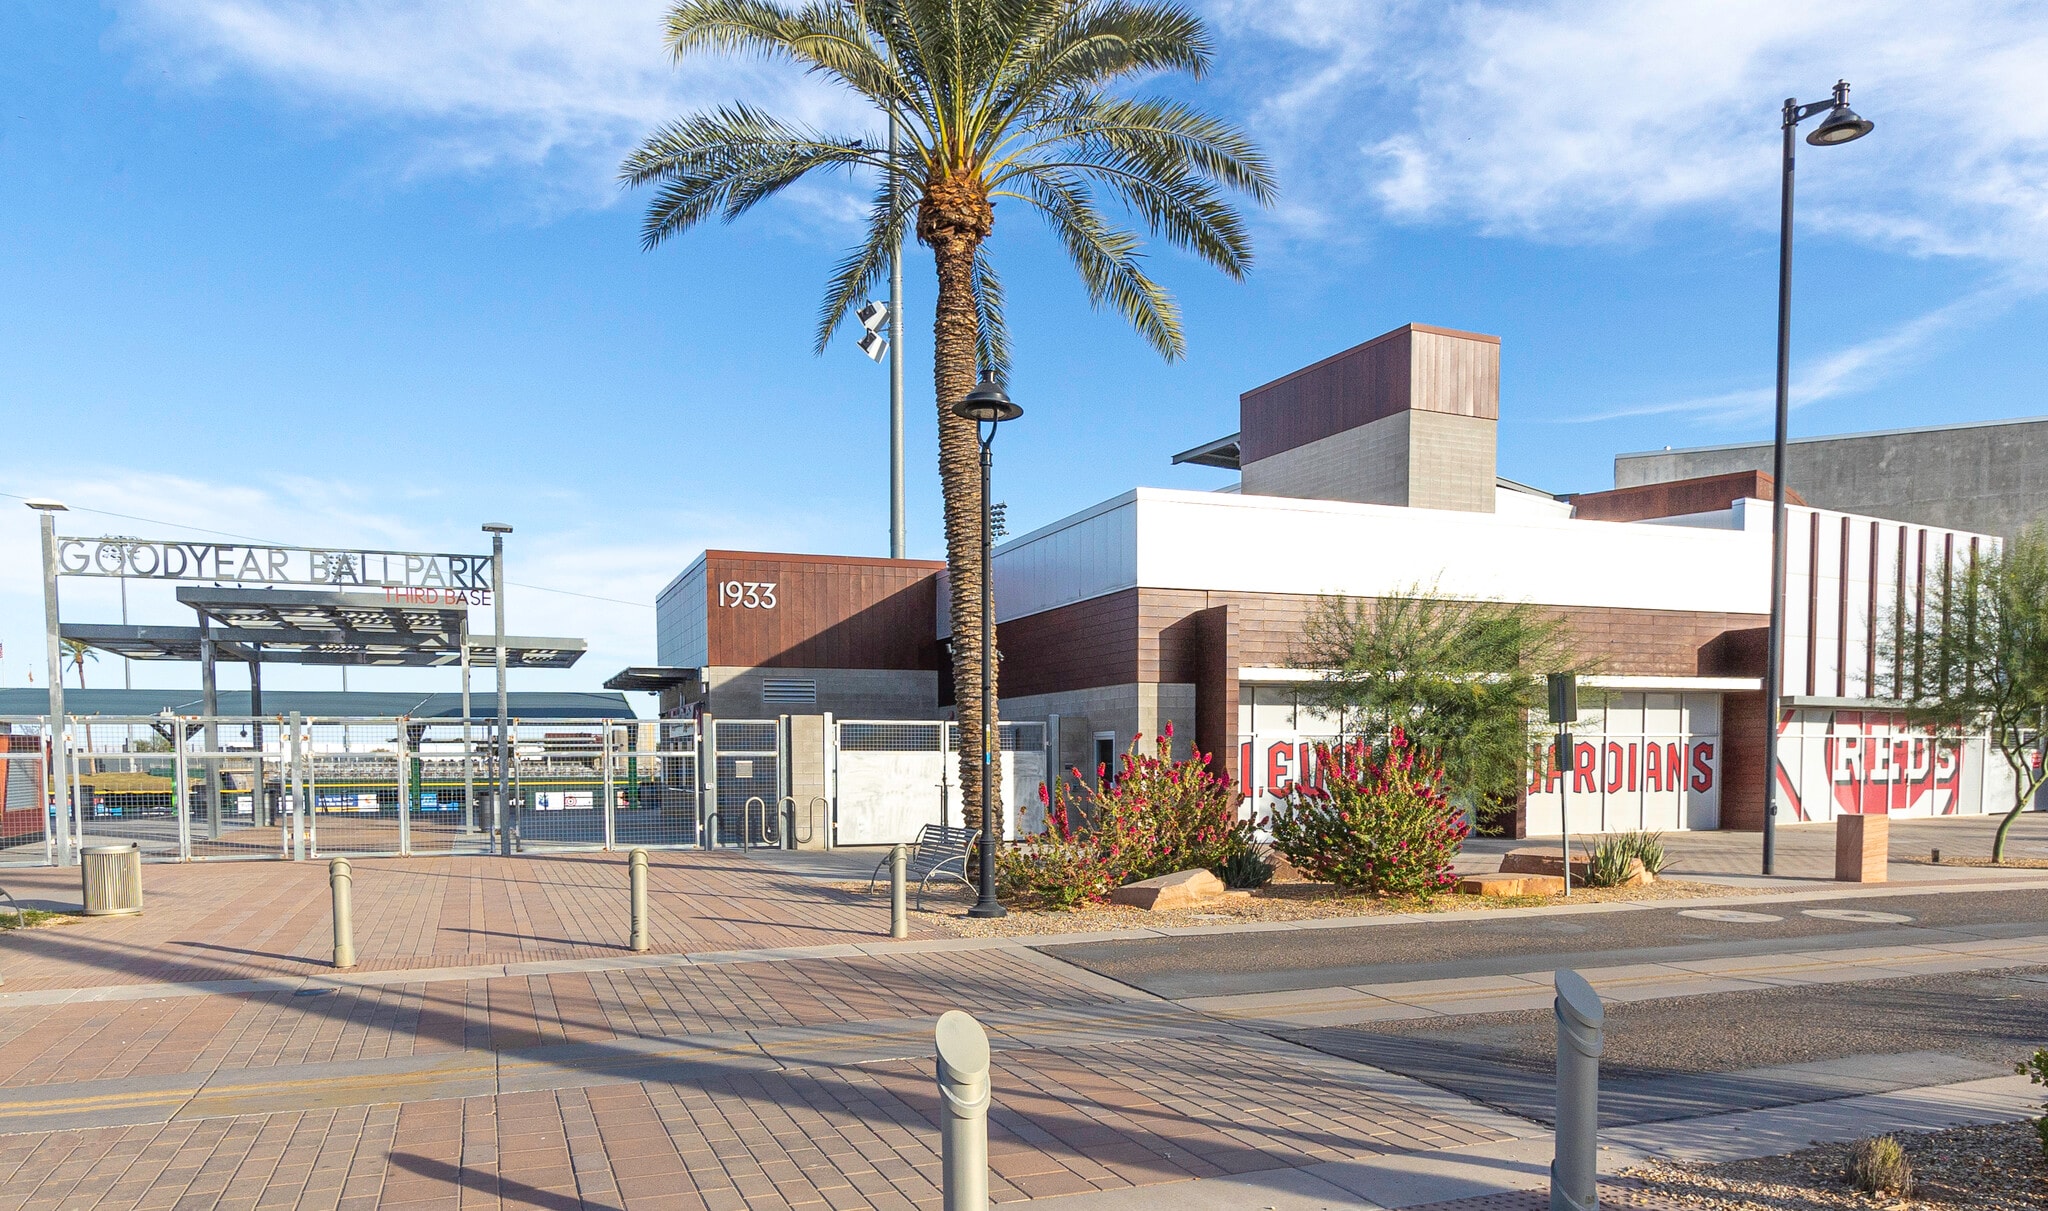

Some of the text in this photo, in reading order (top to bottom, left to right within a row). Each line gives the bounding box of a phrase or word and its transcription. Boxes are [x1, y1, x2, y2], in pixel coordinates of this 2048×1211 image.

[60, 540, 491, 589] GOODYEAR BALLPARK
[382, 587, 491, 606] THIRD BASE
[718, 580, 777, 609] 1933
[1833, 723, 1957, 784] REDS
